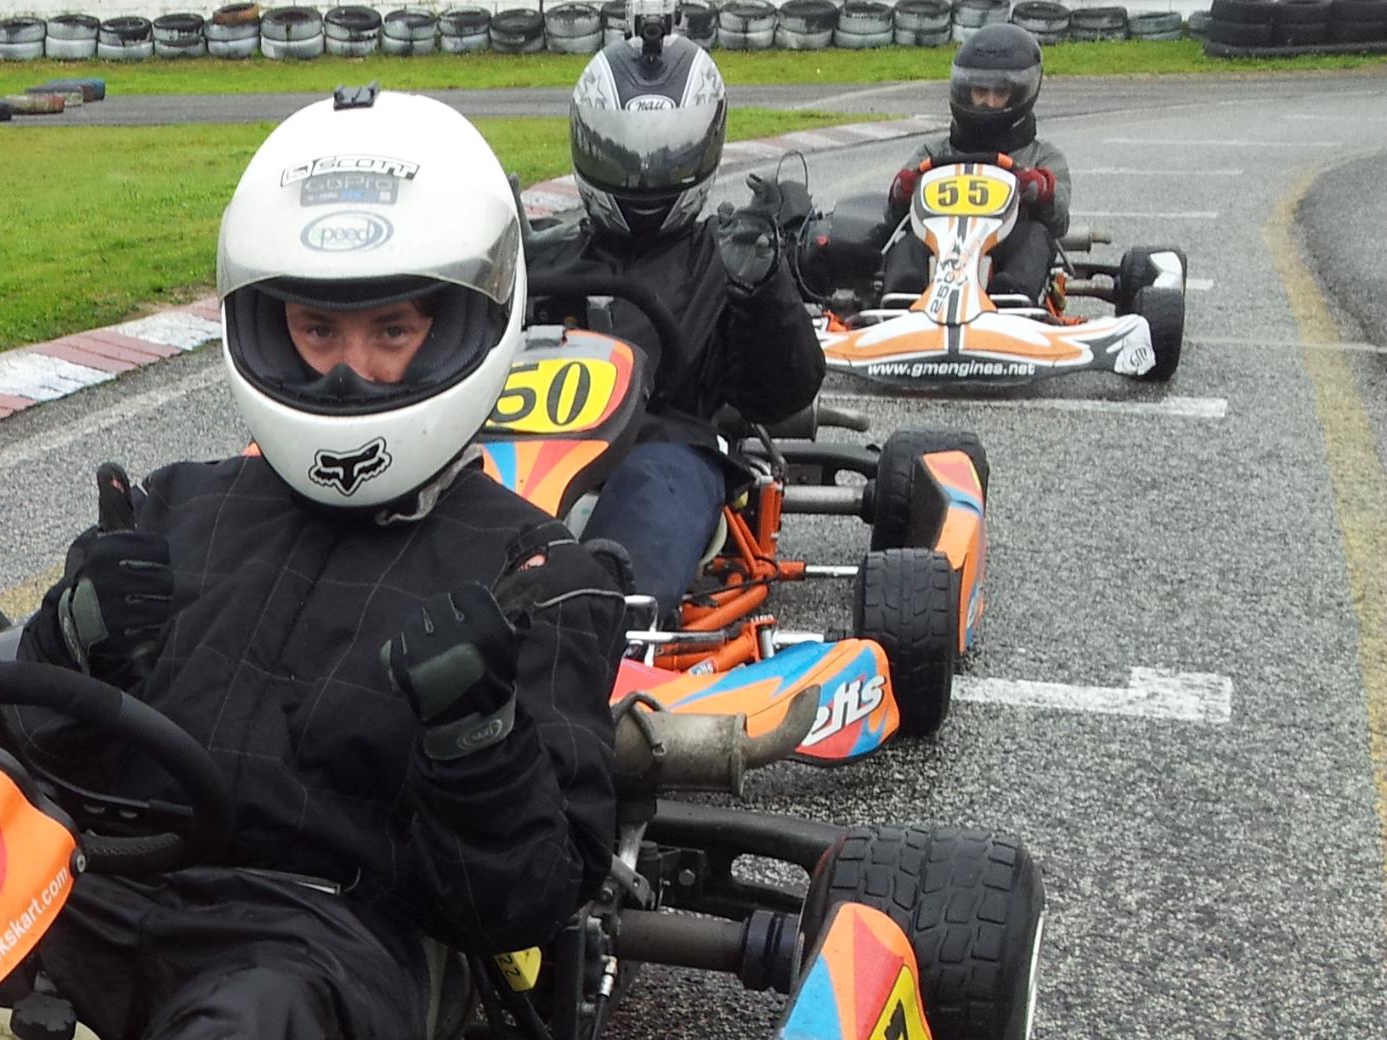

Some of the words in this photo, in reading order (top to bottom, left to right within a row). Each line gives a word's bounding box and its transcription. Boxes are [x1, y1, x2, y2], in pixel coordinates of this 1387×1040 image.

[304, 174, 393, 193] GoPro
[938, 180, 989, 207] 55
[867, 360, 1035, 377] www.gmengines.net
[488, 361, 591, 426] 50
